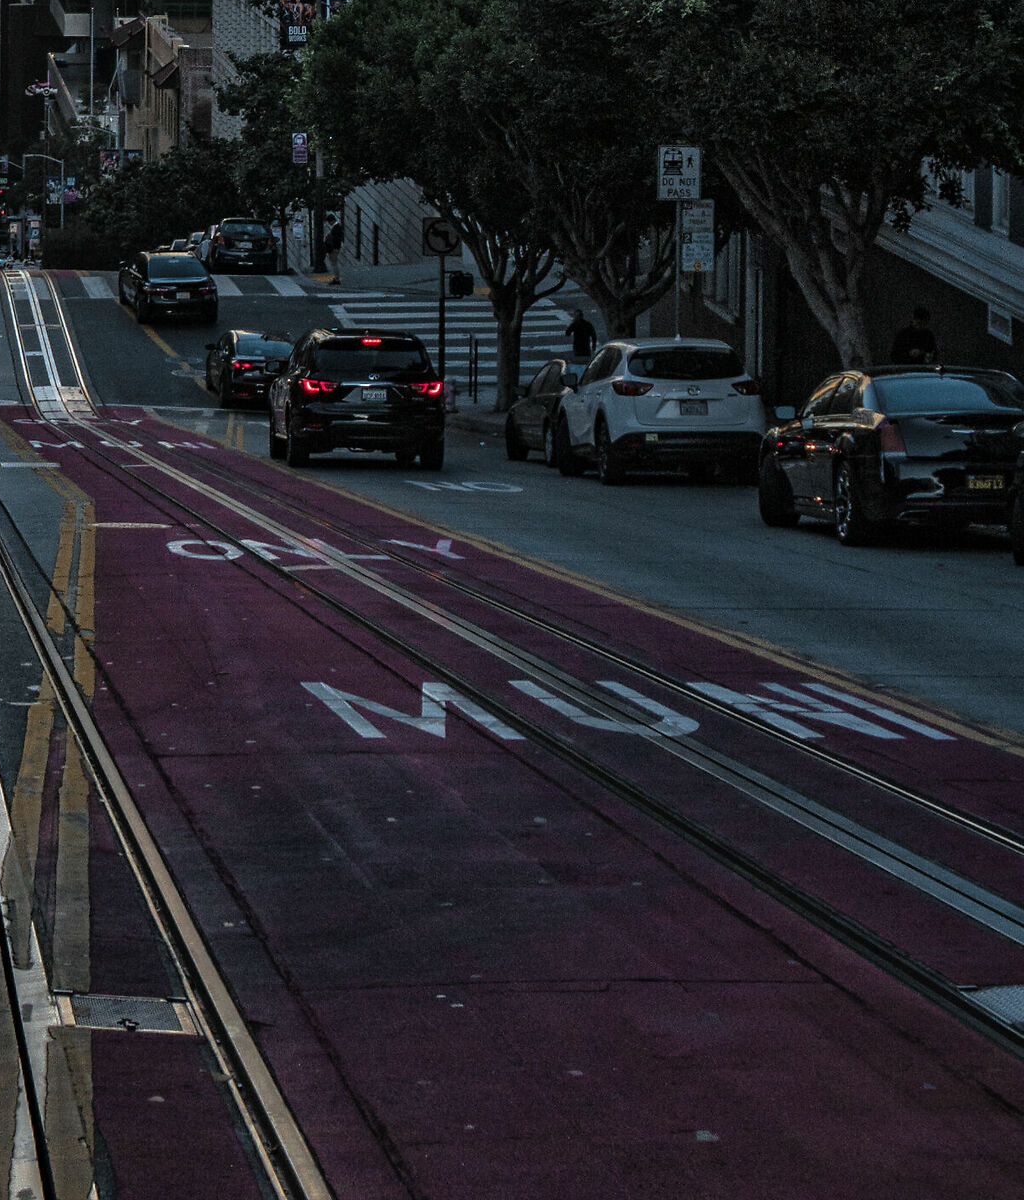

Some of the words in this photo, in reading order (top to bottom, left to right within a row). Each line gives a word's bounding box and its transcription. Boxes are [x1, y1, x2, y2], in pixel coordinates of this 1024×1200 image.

[288, 26, 307, 35] BOLD
[662, 178, 674, 186] DO
[679, 178, 696, 186] NOT
[667, 189, 691, 197] PASS
[300, 679, 959, 741] MUNI
